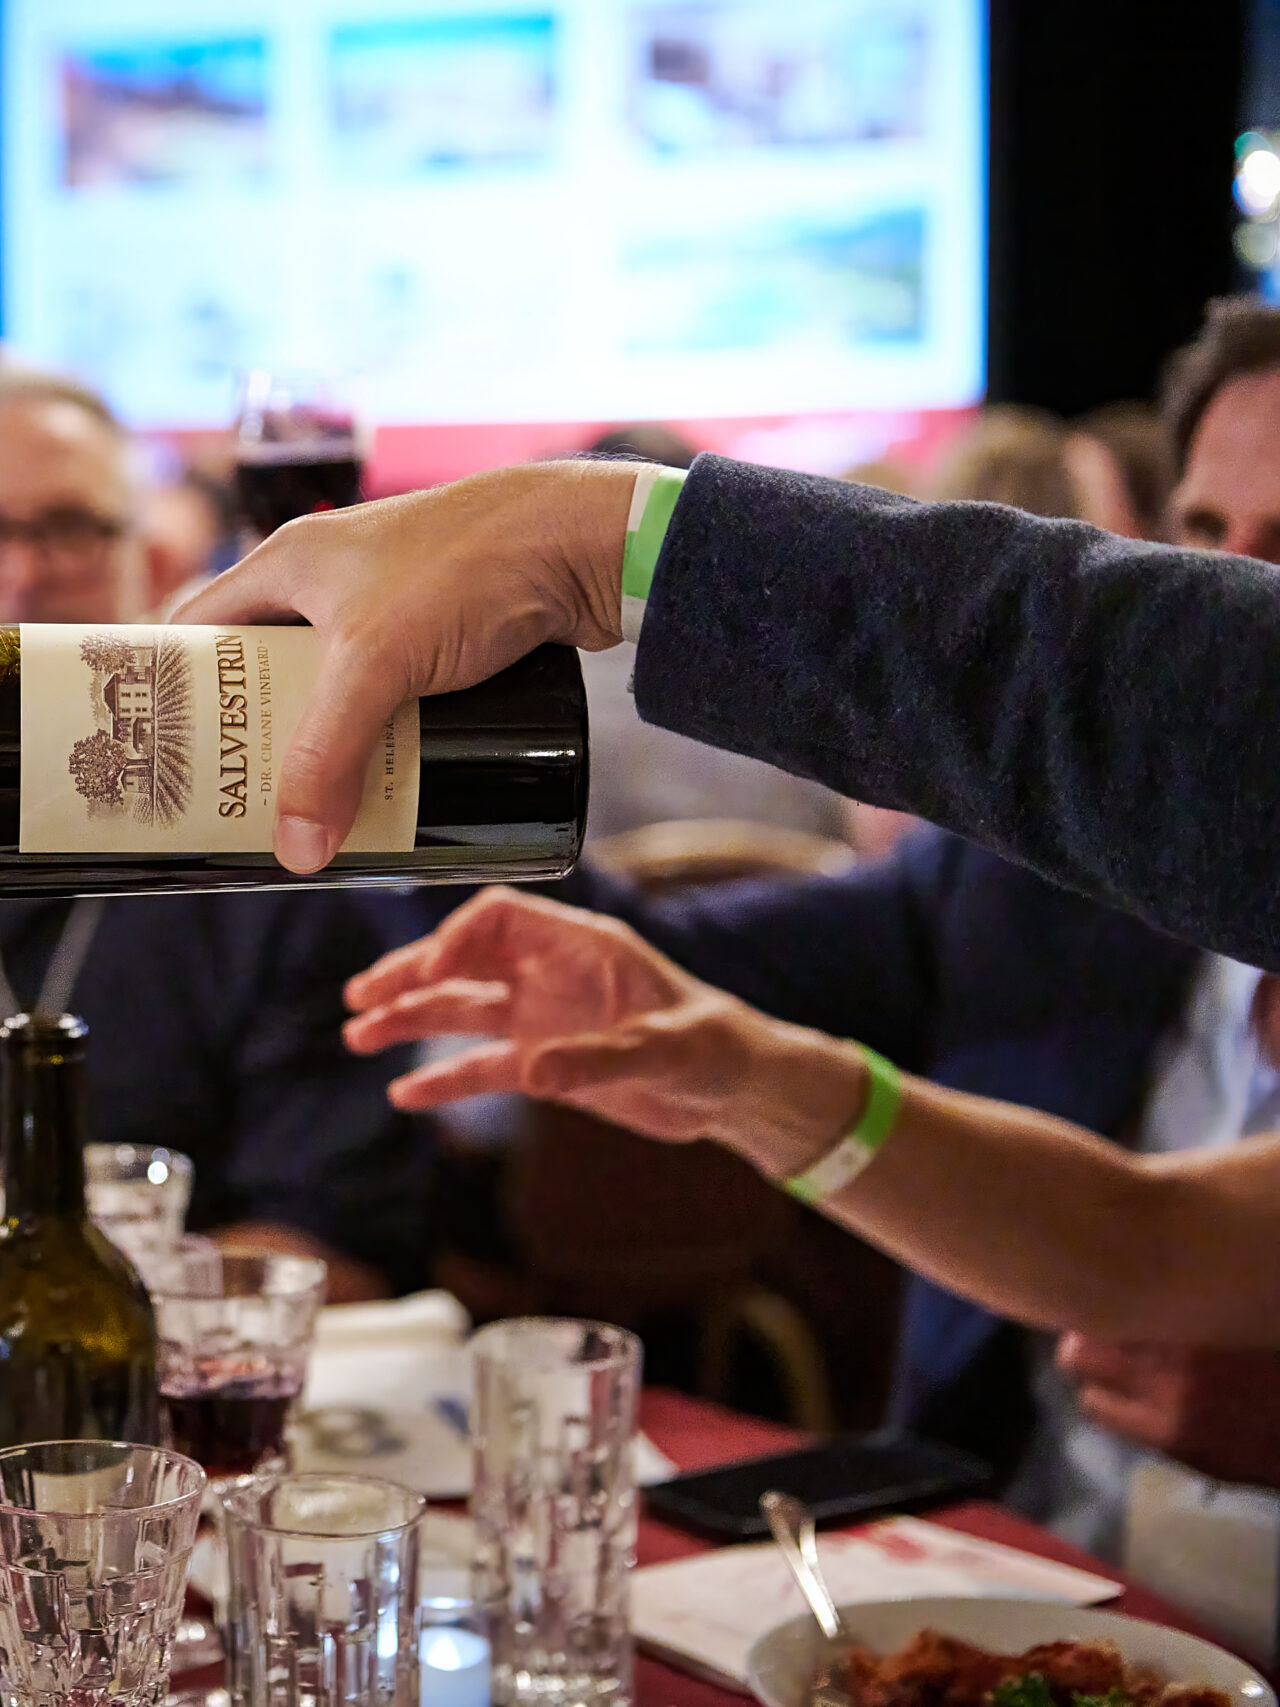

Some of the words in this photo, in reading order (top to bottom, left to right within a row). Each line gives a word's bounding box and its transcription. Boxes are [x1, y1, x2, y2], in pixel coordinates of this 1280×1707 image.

[257, 645, 271, 706] VINEYARD
[216, 634, 248, 818] SALVESTRIN
[260, 711, 272, 763] CRANE
[260, 767, 273, 793] DR.
